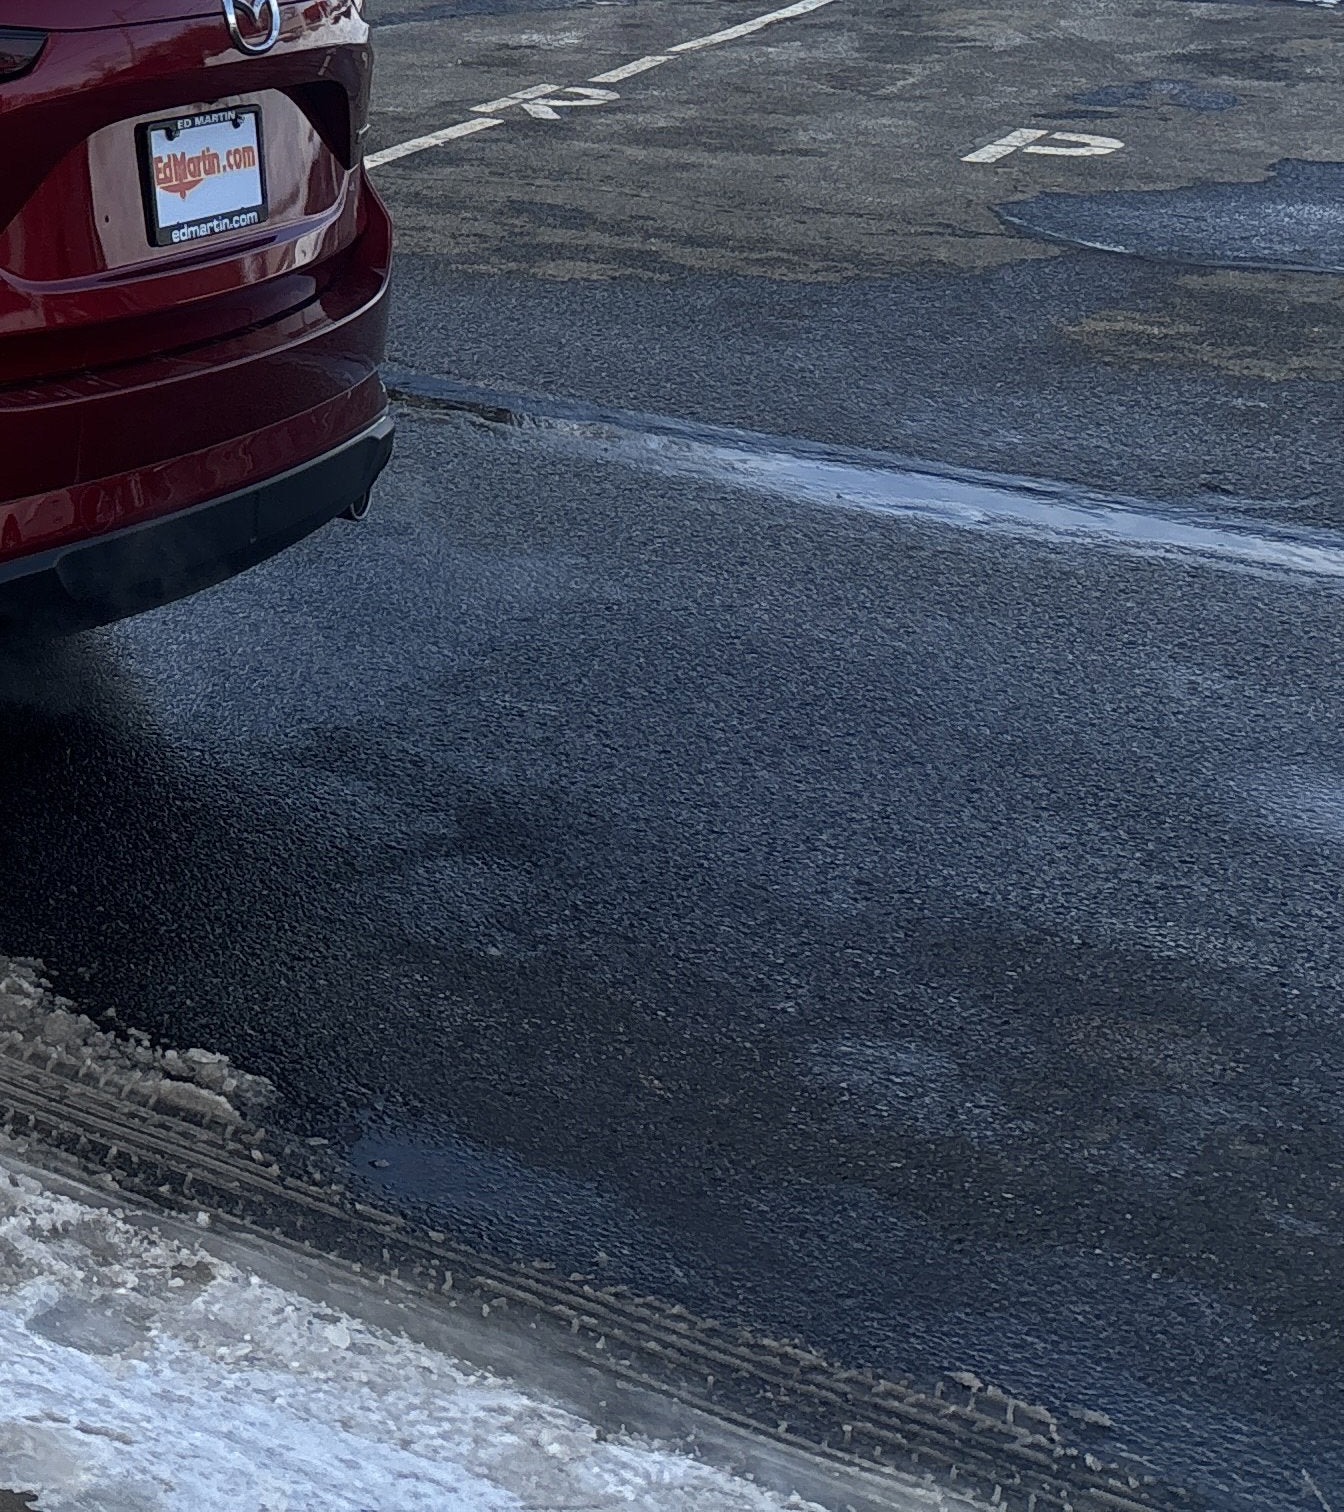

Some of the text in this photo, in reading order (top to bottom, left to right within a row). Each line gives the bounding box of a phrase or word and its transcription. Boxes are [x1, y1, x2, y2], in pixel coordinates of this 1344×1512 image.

[177, 110, 237, 130] ED MARTIN
[153, 145, 256, 186] EdMartin.com
[171, 210, 259, 243] edmartin.com
